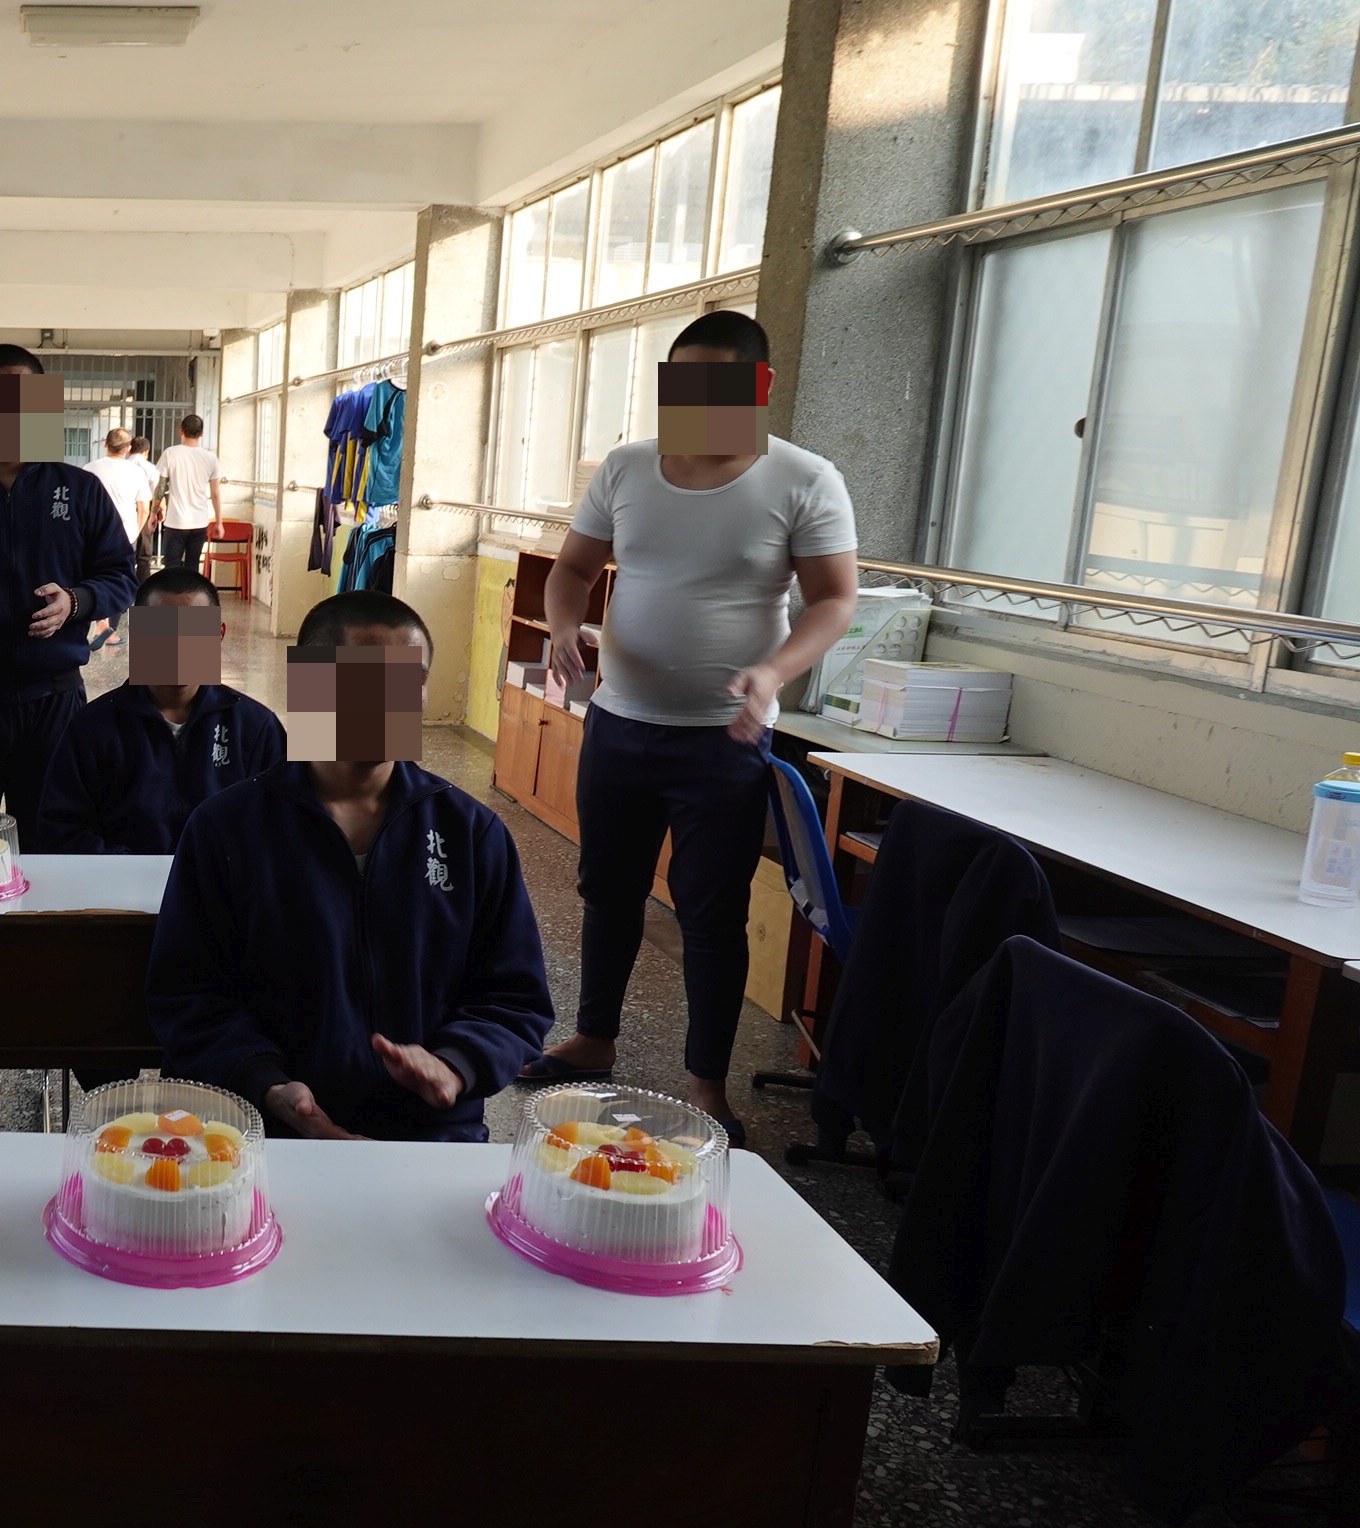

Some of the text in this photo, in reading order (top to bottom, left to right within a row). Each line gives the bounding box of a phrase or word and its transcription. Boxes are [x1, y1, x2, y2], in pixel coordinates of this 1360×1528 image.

[50, 486, 71, 520] 北觀
[211, 724, 230, 764] 北觀
[425, 829, 454, 891] 北觀
